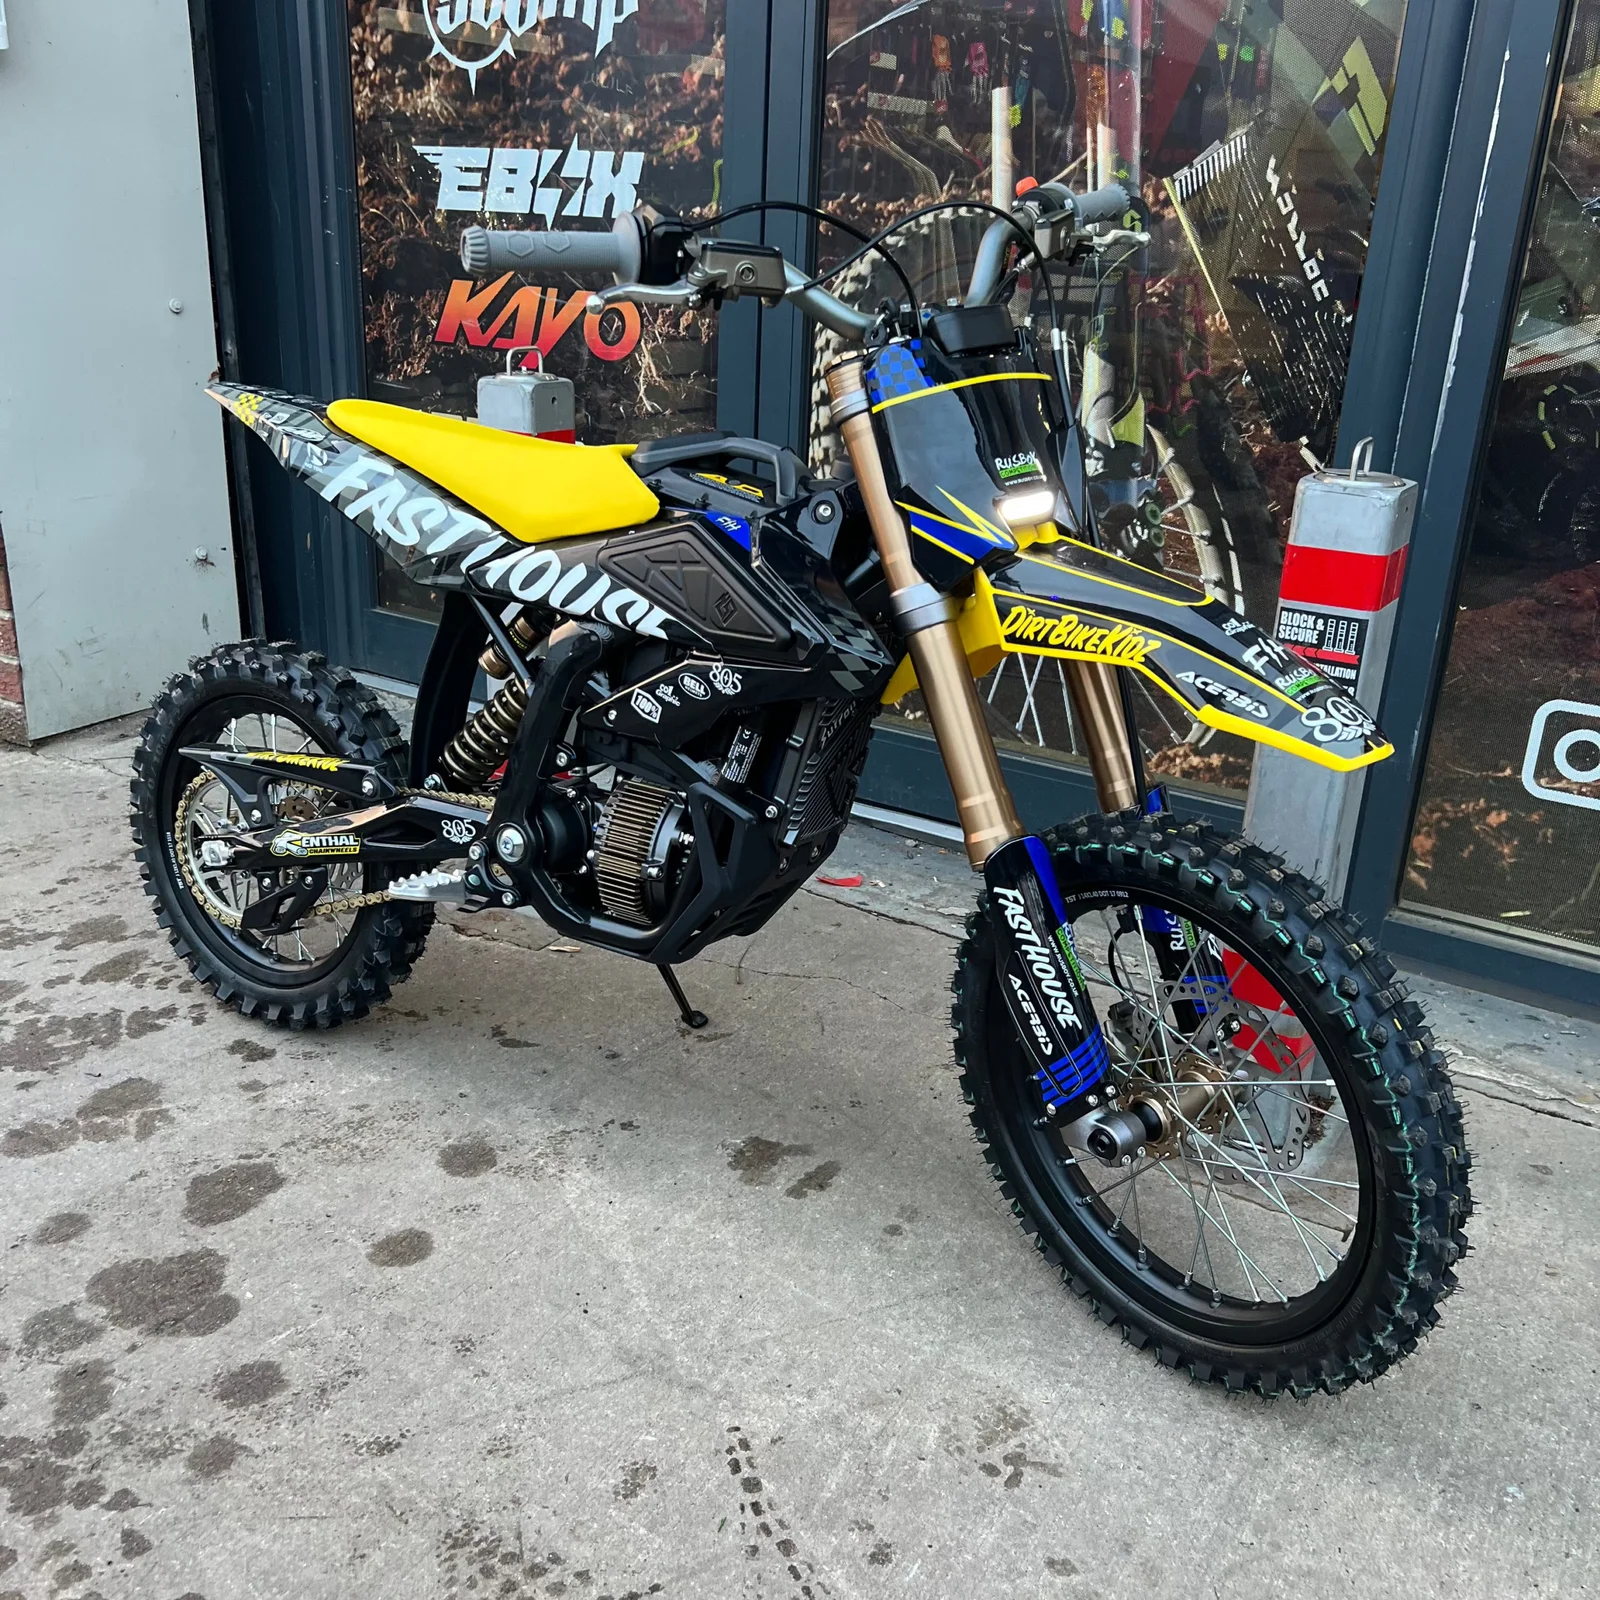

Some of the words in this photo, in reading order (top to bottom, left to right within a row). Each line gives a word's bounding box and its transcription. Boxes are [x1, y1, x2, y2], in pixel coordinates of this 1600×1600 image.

[1280, 611, 1316, 629] BLOCK
[1316, 618, 1325, 631] &
[1278, 625, 1320, 644] SECURE
[709, 662, 743, 693] 805
[1313, 663, 1357, 680] TALLATION
[682, 675, 706, 695] BELL
[1175, 671, 1270, 720] ACERBIS
[635, 695, 658, 719] 100%
[441, 819, 476, 838] 805
[993, 886, 1083, 1031] FASTHOUSE
[1008, 973, 1054, 1056] ACERBIS
